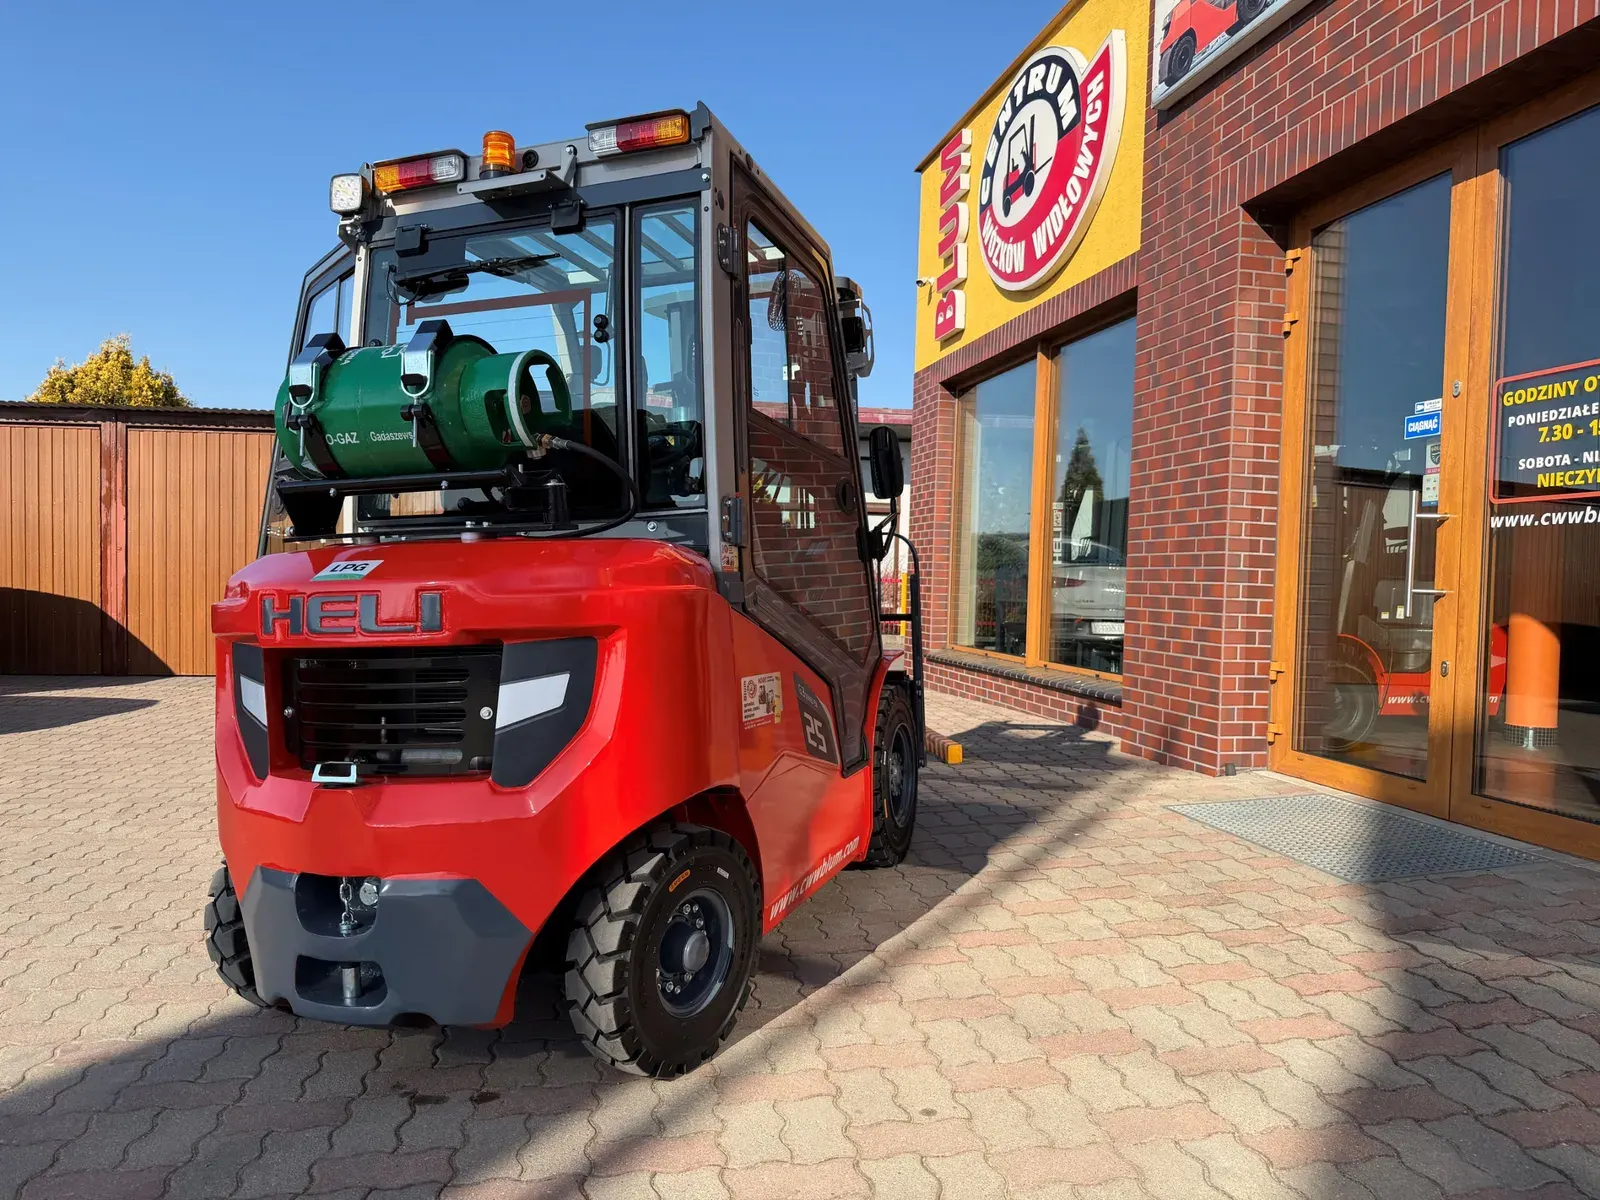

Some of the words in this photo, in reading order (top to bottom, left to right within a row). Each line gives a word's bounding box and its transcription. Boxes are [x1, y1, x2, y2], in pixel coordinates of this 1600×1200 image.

[981, 62, 1079, 206] CENTRUM
[981, 210, 1026, 274] WÓZKÓW
[1032, 70, 1104, 260] WIDŁOWYCH
[935, 129, 968, 342] BLUM
[1503, 379, 1579, 406] GODZINY
[1584, 374, 1600, 392] O
[1408, 416, 1438, 433] CIĄGNĄĆ
[1508, 402, 1600, 428] PONIEDZIAŁE
[1538, 423, 1573, 443] 7.30
[1518, 453, 1571, 470] SOBOTA
[1583, 450, 1600, 464] NI
[330, 562, 370, 573] LPG
[261, 592, 443, 635] HELI
[804, 711, 827, 754] 25
[769, 835, 860, 921] www.cwwblum.com
